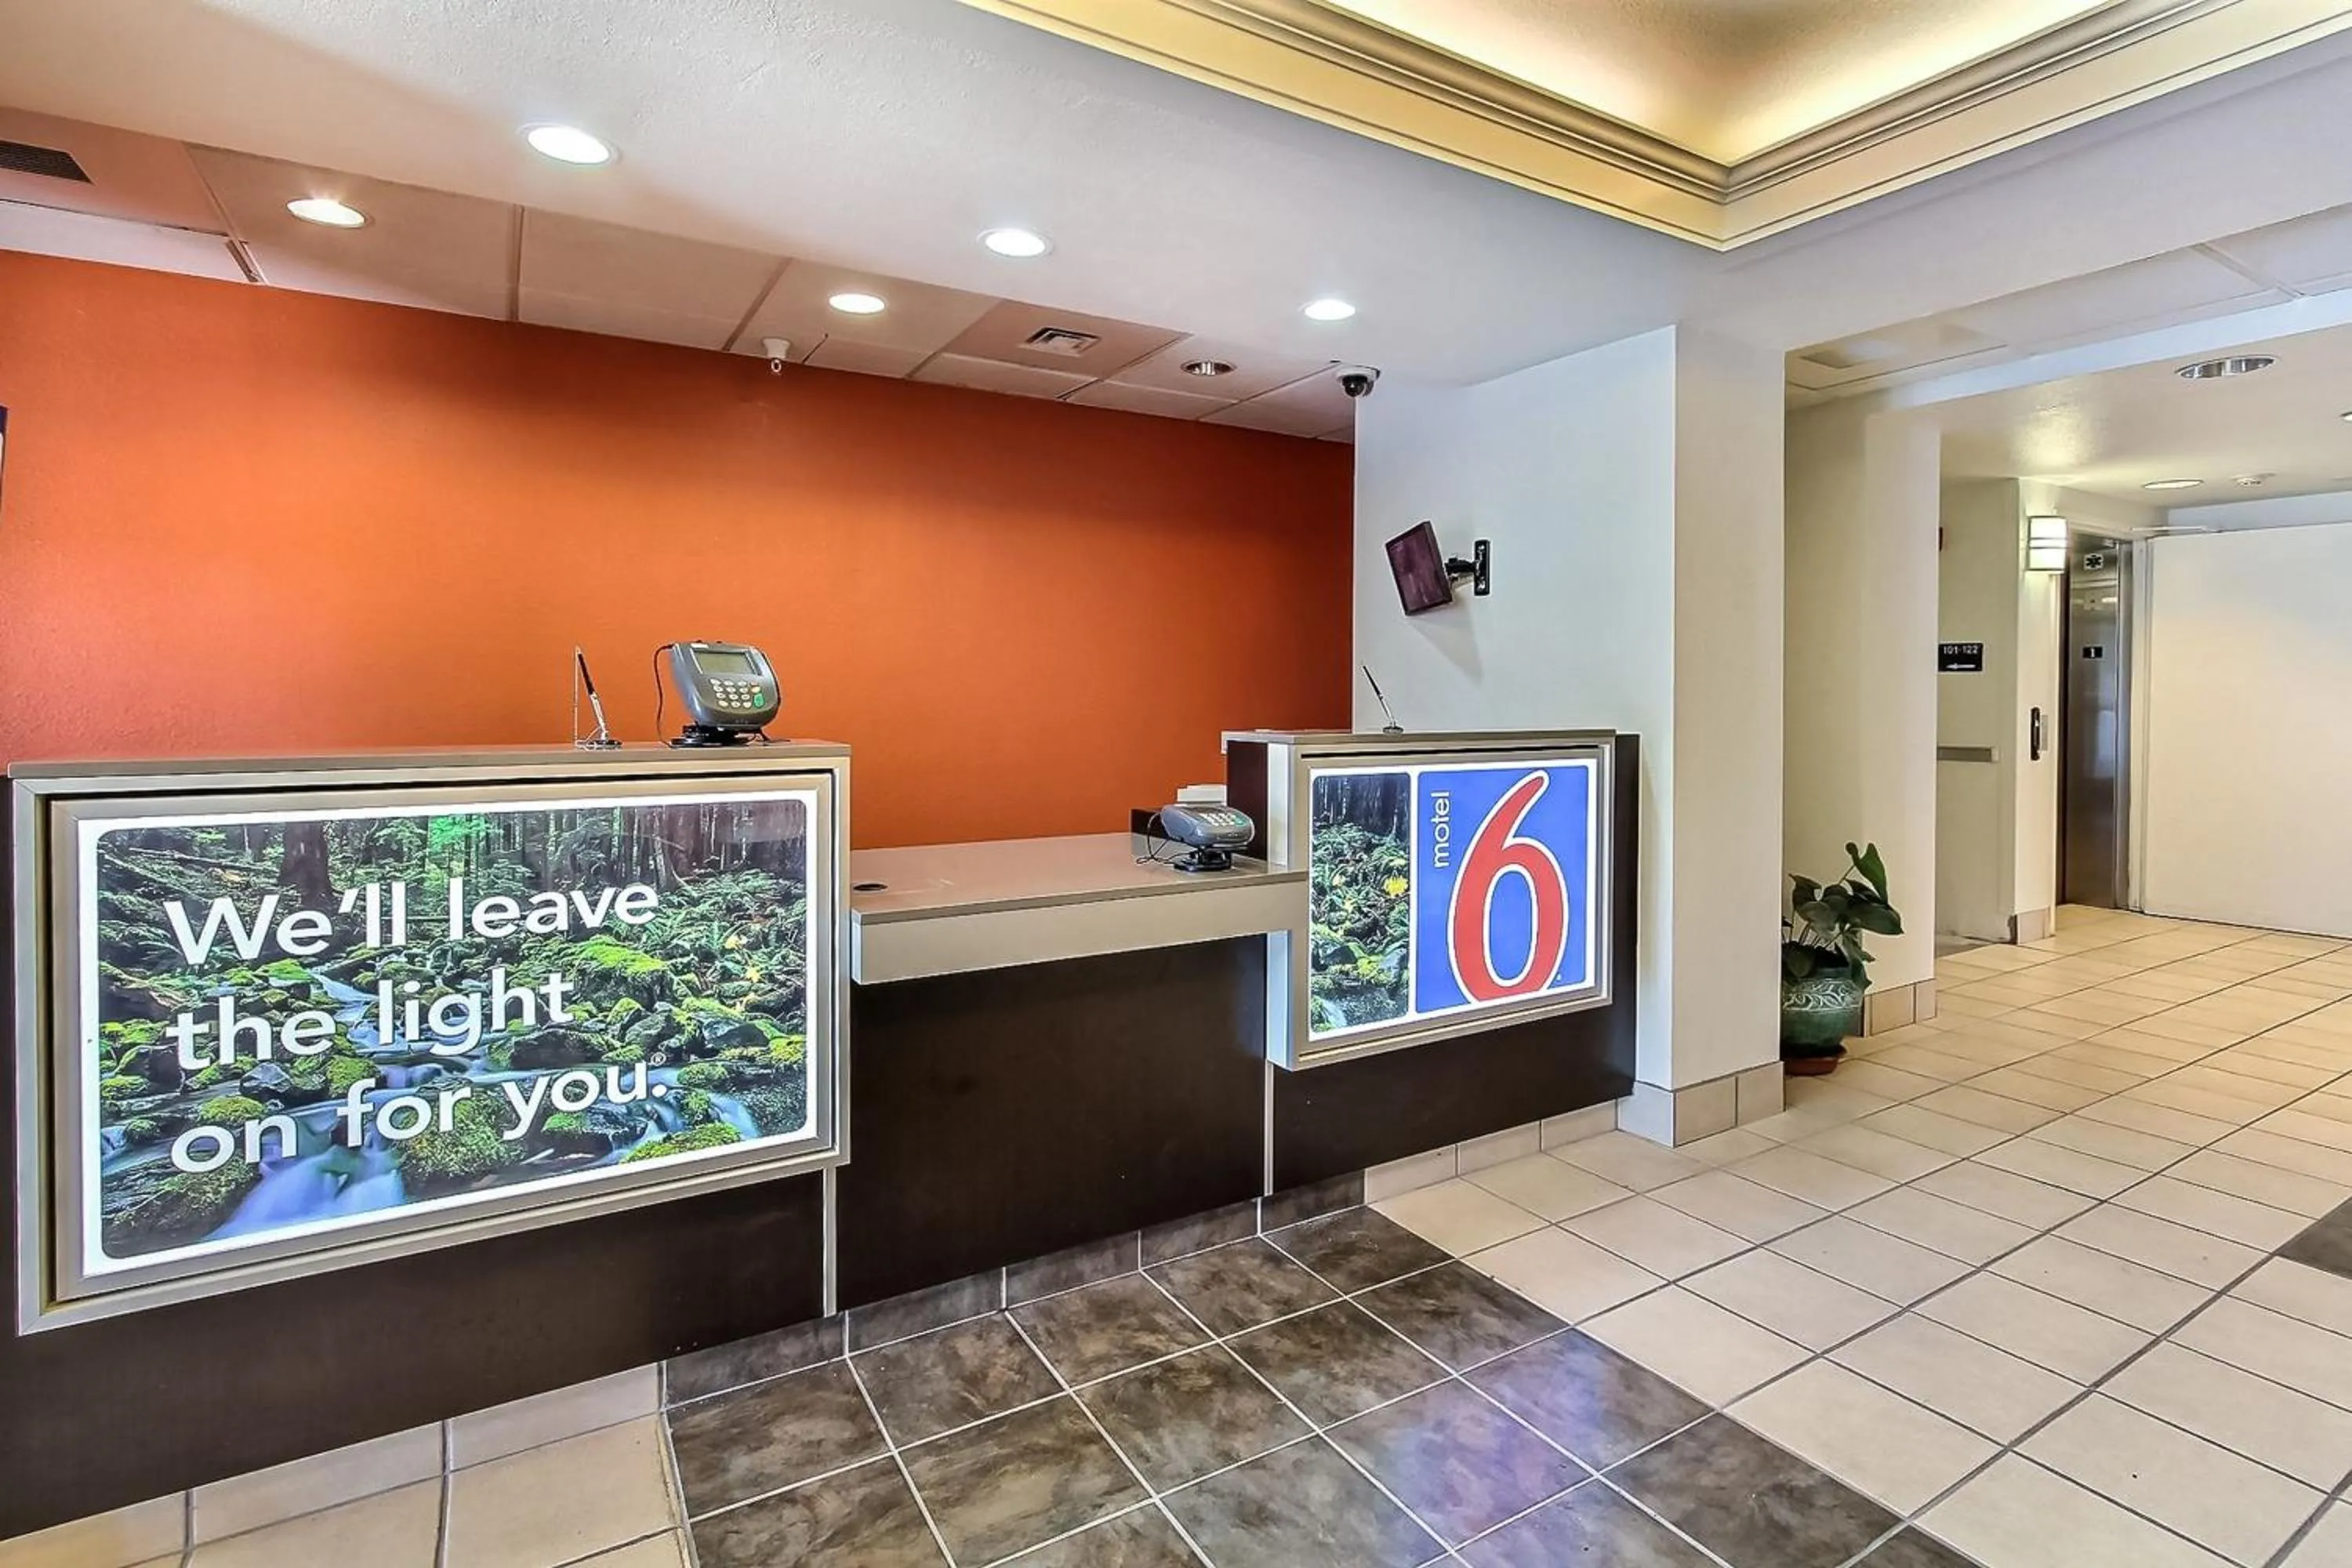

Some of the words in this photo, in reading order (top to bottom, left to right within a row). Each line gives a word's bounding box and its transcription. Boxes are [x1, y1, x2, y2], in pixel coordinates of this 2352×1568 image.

[1430, 790, 1450, 869] motel
[162, 877, 408, 966] We'll
[448, 877, 659, 941] leave
[1446, 768, 1570, 1004] 6
[165, 996, 337, 1072] the
[378, 967, 575, 1056] light
[169, 1114, 298, 1174] on
[336, 1078, 470, 1149] for
